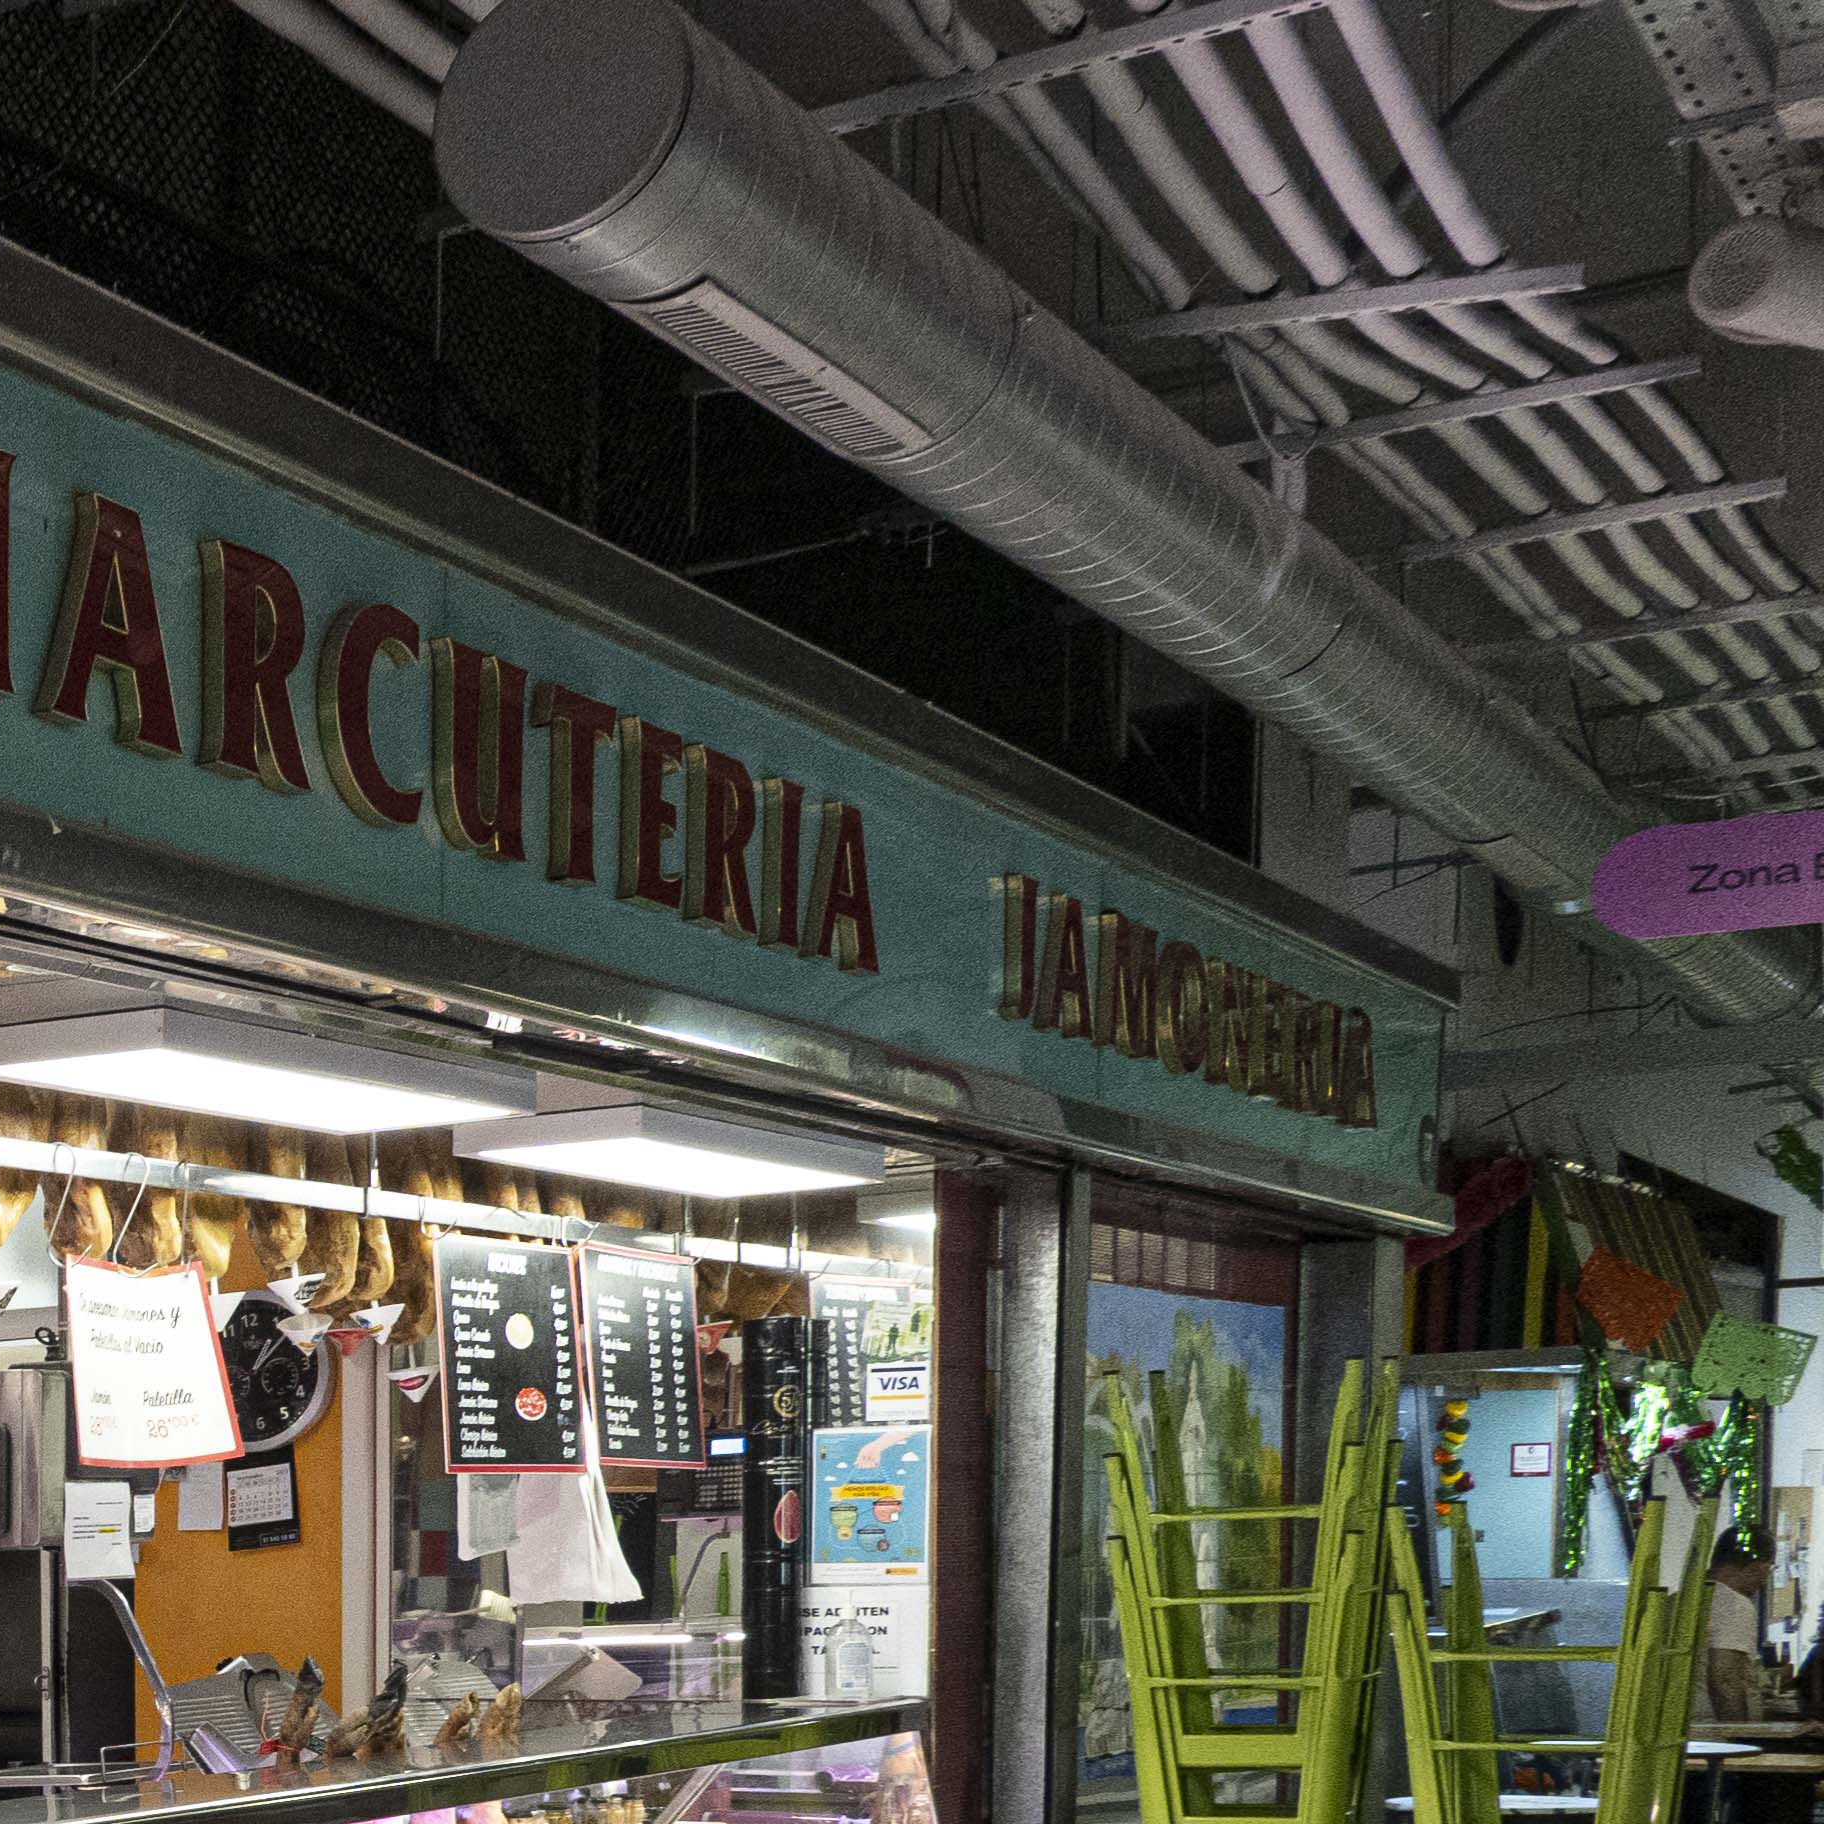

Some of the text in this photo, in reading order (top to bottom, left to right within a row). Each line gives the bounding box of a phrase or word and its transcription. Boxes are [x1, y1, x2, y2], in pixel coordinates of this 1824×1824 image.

[1687, 857, 1798, 895] Zona
[241, 1313, 259, 1328] 12
[878, 1376, 920, 1391] VISA
[143, 1389, 194, 1407] Paletilla
[296, 1385, 305, 1398] 4
[279, 1407, 289, 1420] 5
[256, 1417, 266, 1430] 6
